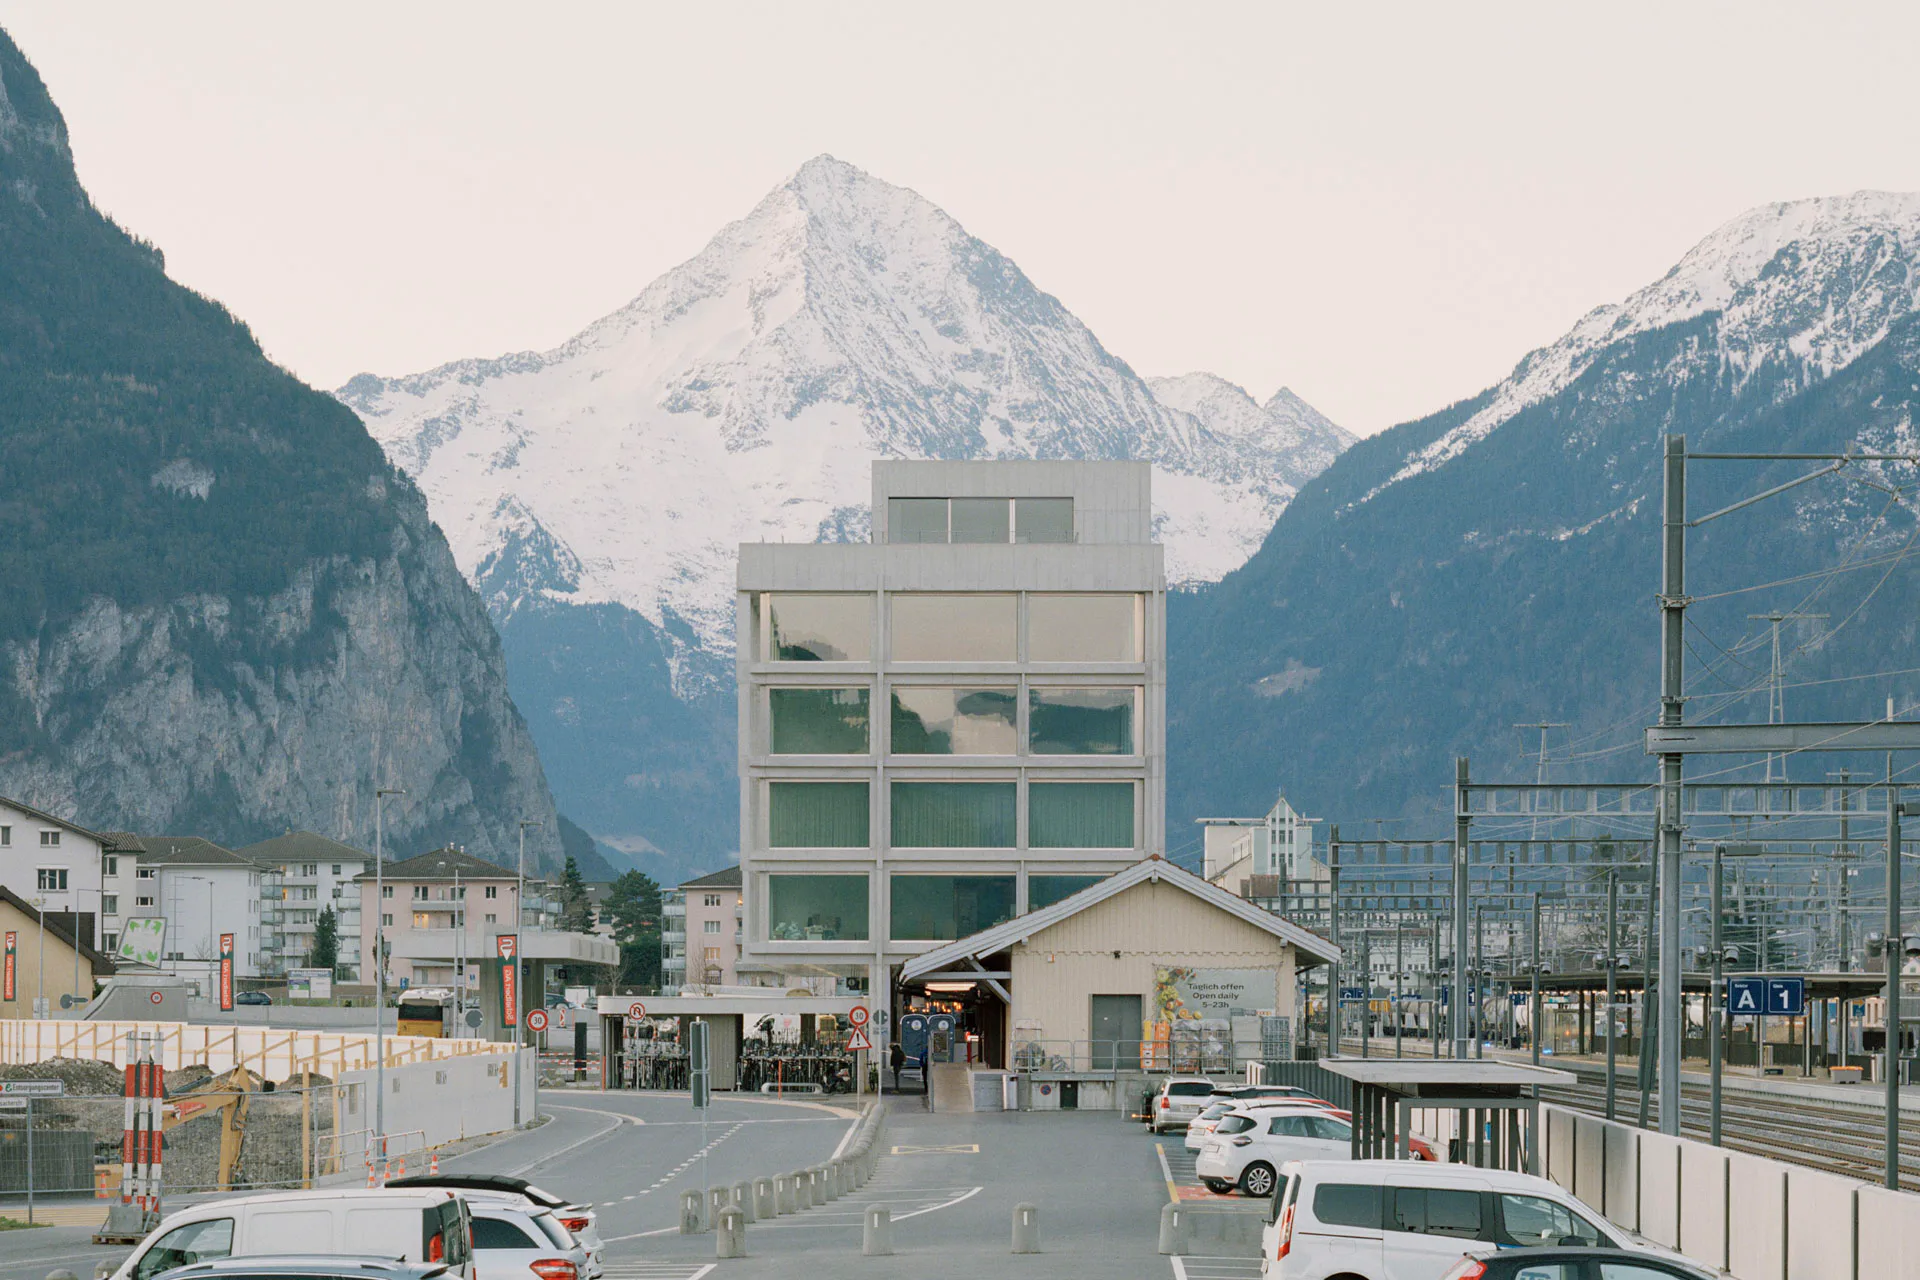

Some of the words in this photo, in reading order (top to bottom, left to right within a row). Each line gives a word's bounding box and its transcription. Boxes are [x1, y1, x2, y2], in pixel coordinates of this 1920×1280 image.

[1192, 992, 1216, 1000] Open
[1217, 992, 1240, 1000] daily
[1737, 989, 1756, 1009] A
[1779, 989, 1789, 1009] 1
[856, 1012, 863, 1020] 30
[534, 1017, 542, 1025] 30
